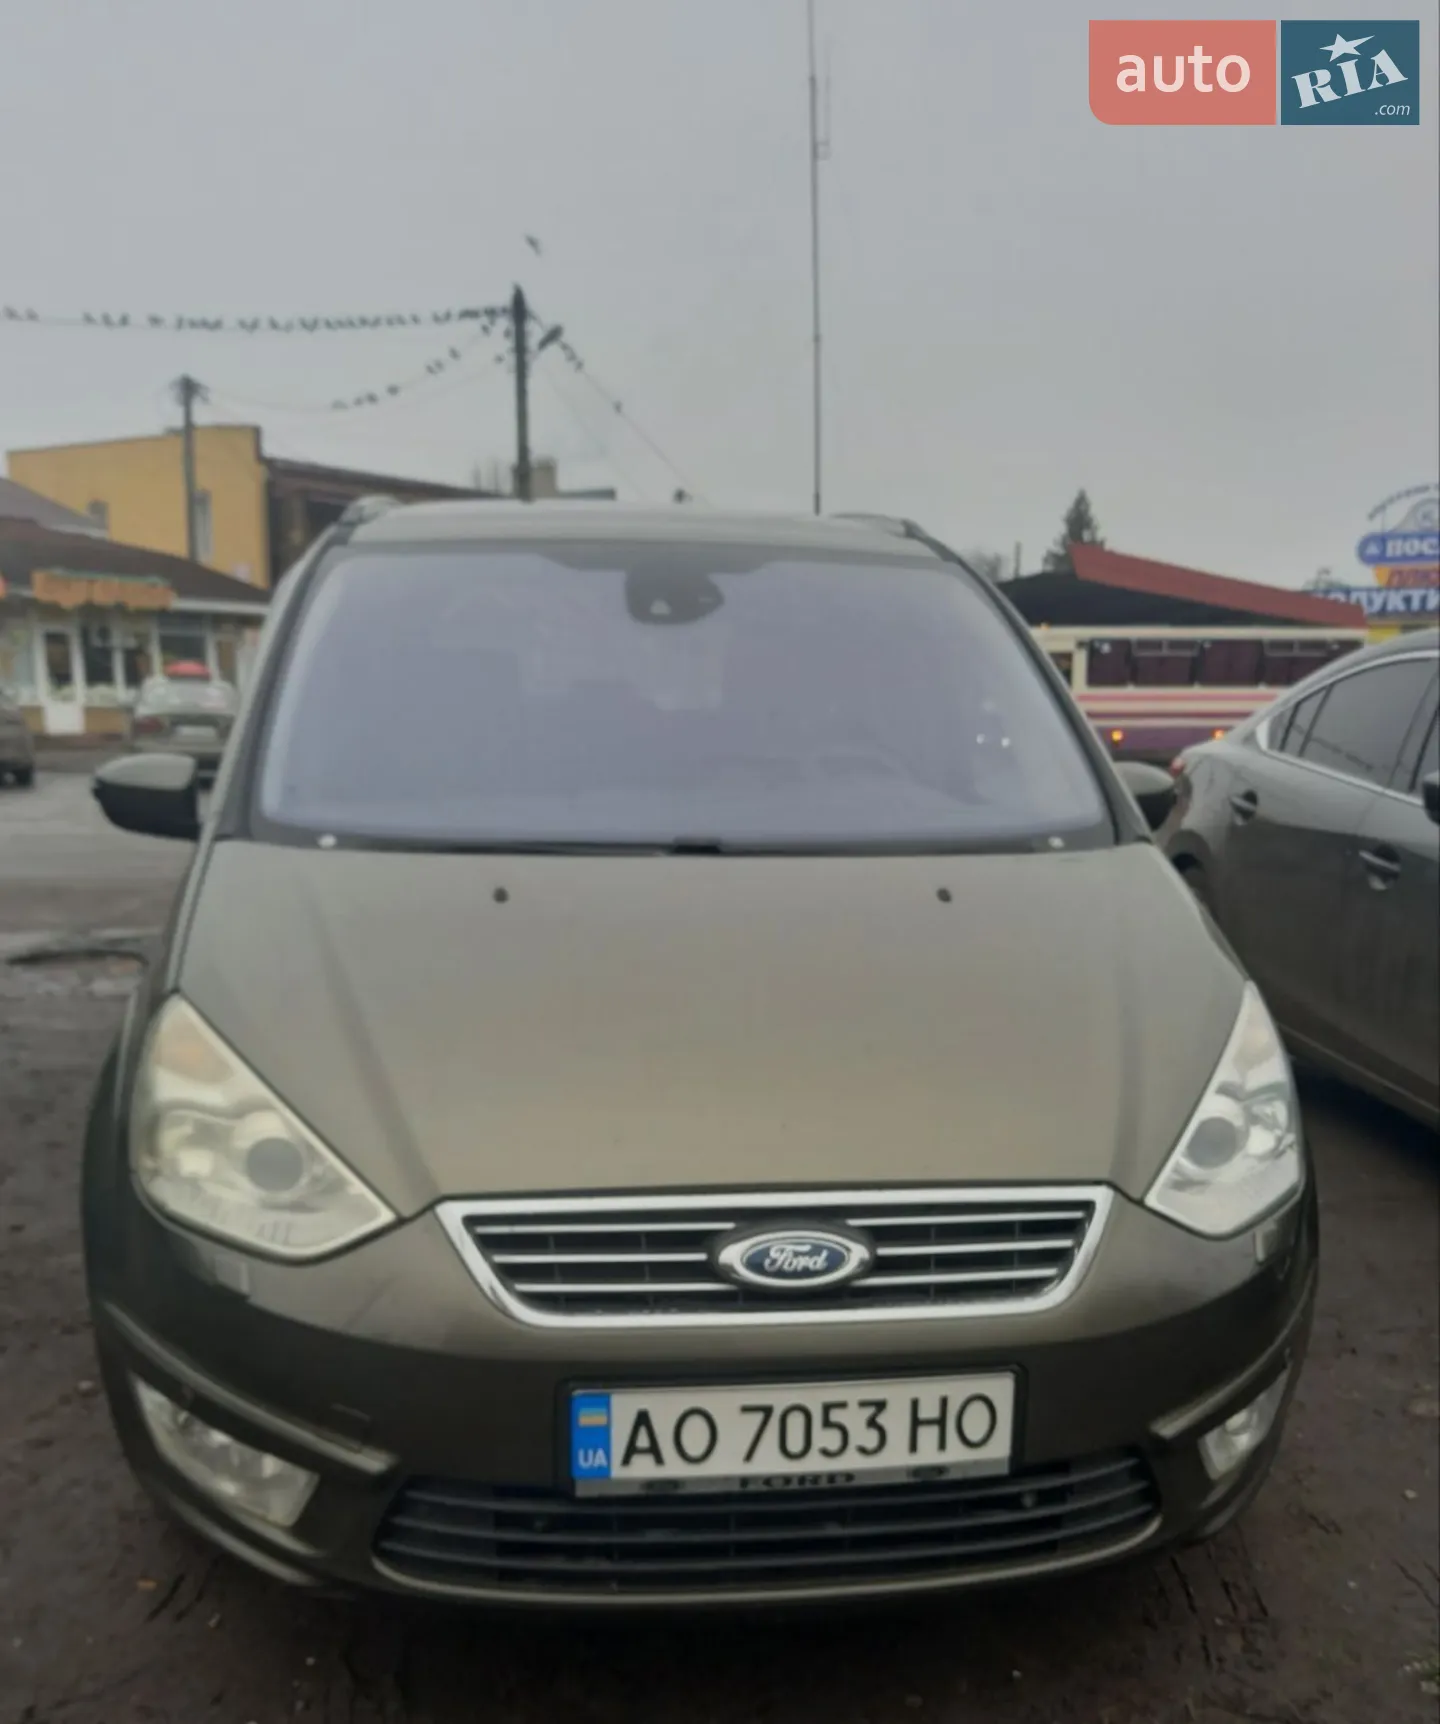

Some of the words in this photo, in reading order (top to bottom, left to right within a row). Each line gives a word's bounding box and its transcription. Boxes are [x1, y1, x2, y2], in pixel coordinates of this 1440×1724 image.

[764, 1244, 828, 1273] Ford
[620, 1407, 718, 1467] AO
[739, 1398, 888, 1463] 7053
[908, 1393, 997, 1456] HO
[578, 1447, 608, 1469] UA
